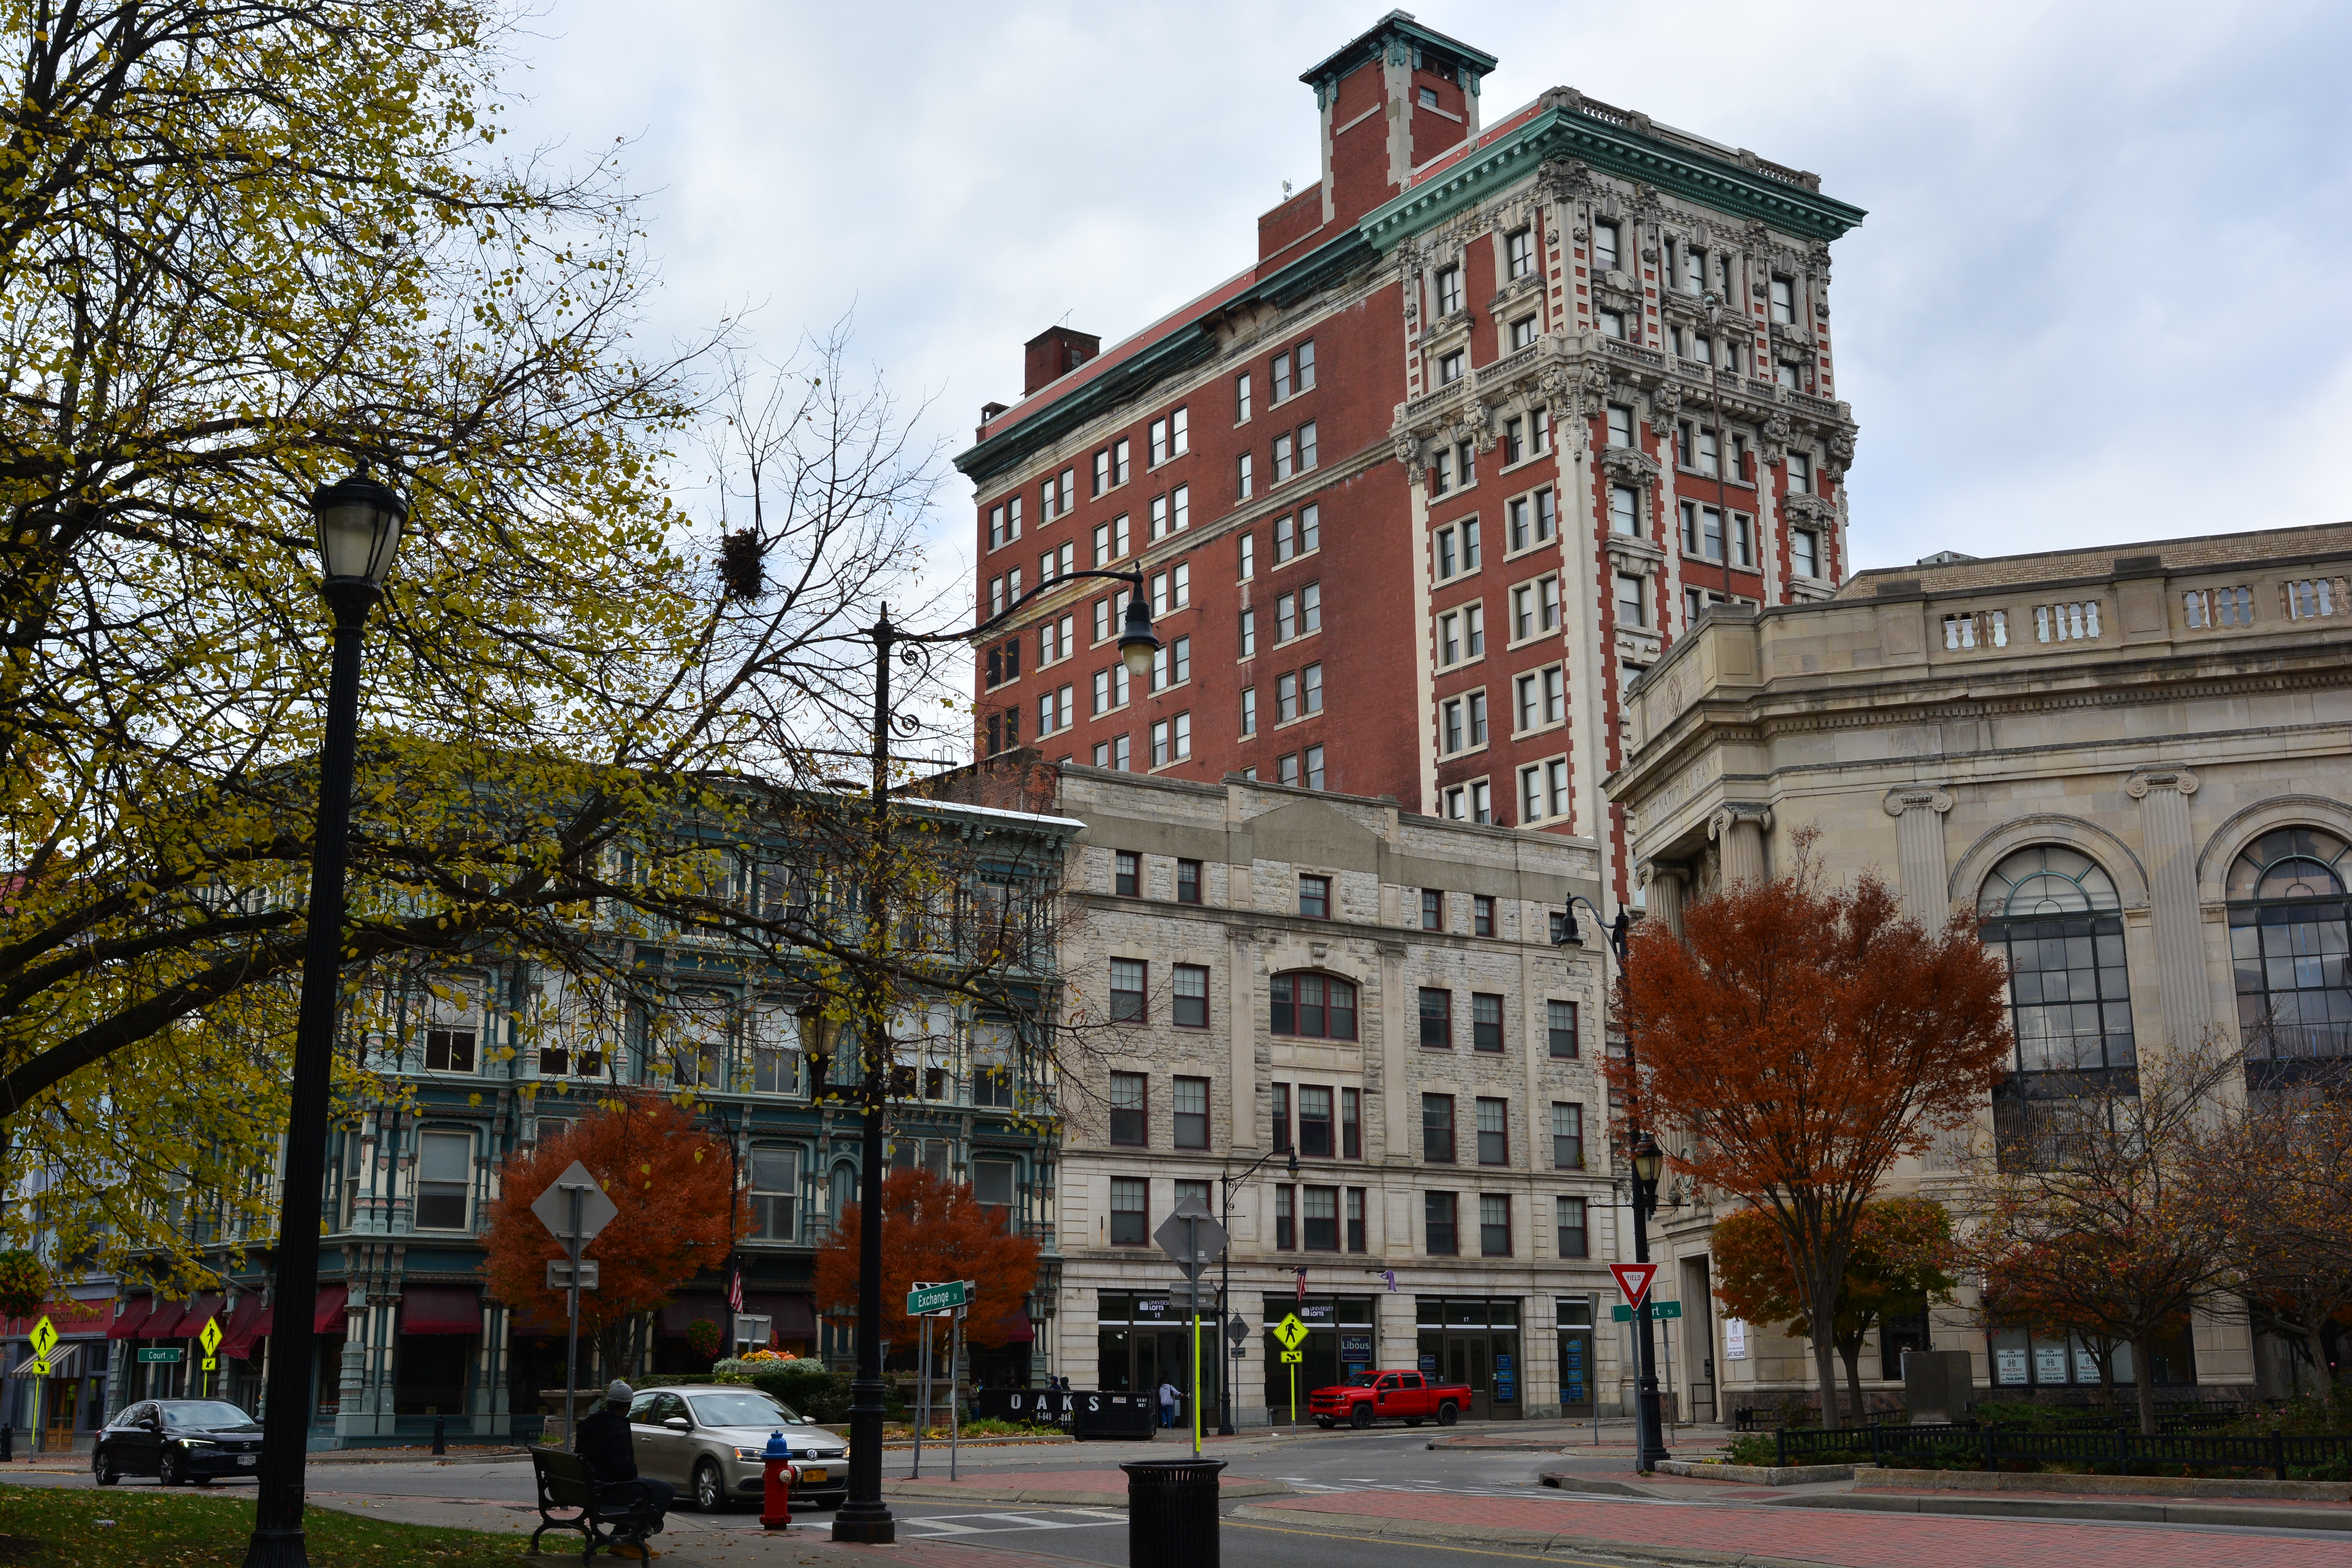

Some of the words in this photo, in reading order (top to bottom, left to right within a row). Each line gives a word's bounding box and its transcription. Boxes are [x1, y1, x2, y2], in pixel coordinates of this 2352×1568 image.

[1639, 802, 1656, 831] FIRST
[1659, 773, 1695, 816] NATIONAL
[1697, 755, 1719, 788] BANK
[918, 1292, 949, 1308] Exchange
[1343, 1341, 1369, 1349] Libous
[1011, 1394, 1099, 1411] OAKS
[1036, 1412, 1052, 1420] 6-649
